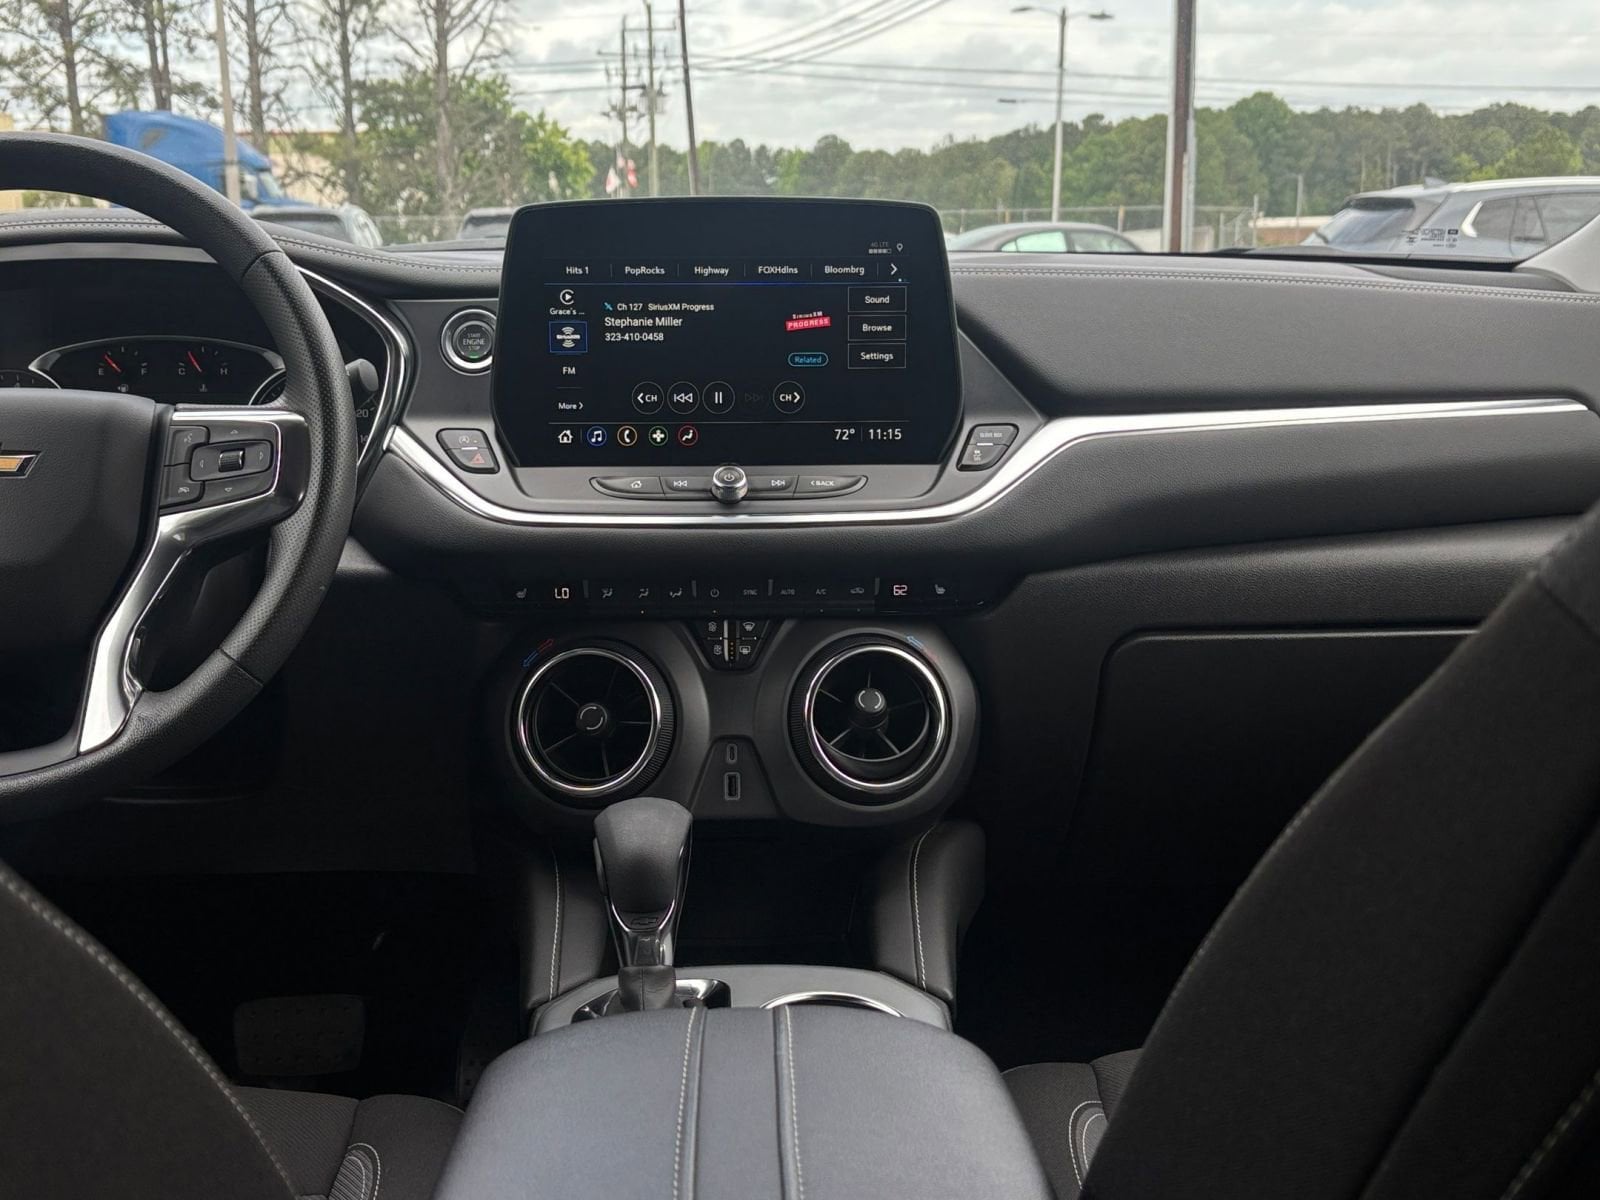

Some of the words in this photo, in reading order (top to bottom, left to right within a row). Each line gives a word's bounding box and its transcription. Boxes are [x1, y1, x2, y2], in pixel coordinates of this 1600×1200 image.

[566, 266, 583, 275] Hits
[585, 266, 590, 275] 1
[624, 266, 665, 276] PopRocks
[694, 266, 729, 277] Highway
[758, 265, 798, 274] FOXHdlns
[824, 265, 865, 276] Bloombrg
[864, 295, 890, 304] Sound
[549, 307, 577, 316] Grace's
[617, 303, 627, 311] Ch
[629, 303, 643, 311] 127
[648, 303, 681, 312] SiriusXM
[681, 303, 714, 312] Progress
[604, 317, 653, 328] Stephanie
[655, 316, 683, 327] Miller
[787, 318, 830, 331] PROGRESS
[862, 323, 893, 332] Browse
[604, 332, 665, 342] 323-410-0458
[794, 355, 822, 364] Related
[860, 351, 894, 361] Settings
[98, 368, 105, 376] E
[141, 368, 148, 376] F
[220, 368, 228, 376] H
[562, 366, 576, 375] FM
[645, 395, 658, 403] CH
[779, 393, 792, 402] CH
[558, 402, 577, 410] More
[356, 408, 369, 418] 20
[868, 428, 902, 440] 11:15
[815, 479, 835, 487] BACK
[815, 587, 827, 596] A/C
[893, 584, 908, 596] 62
